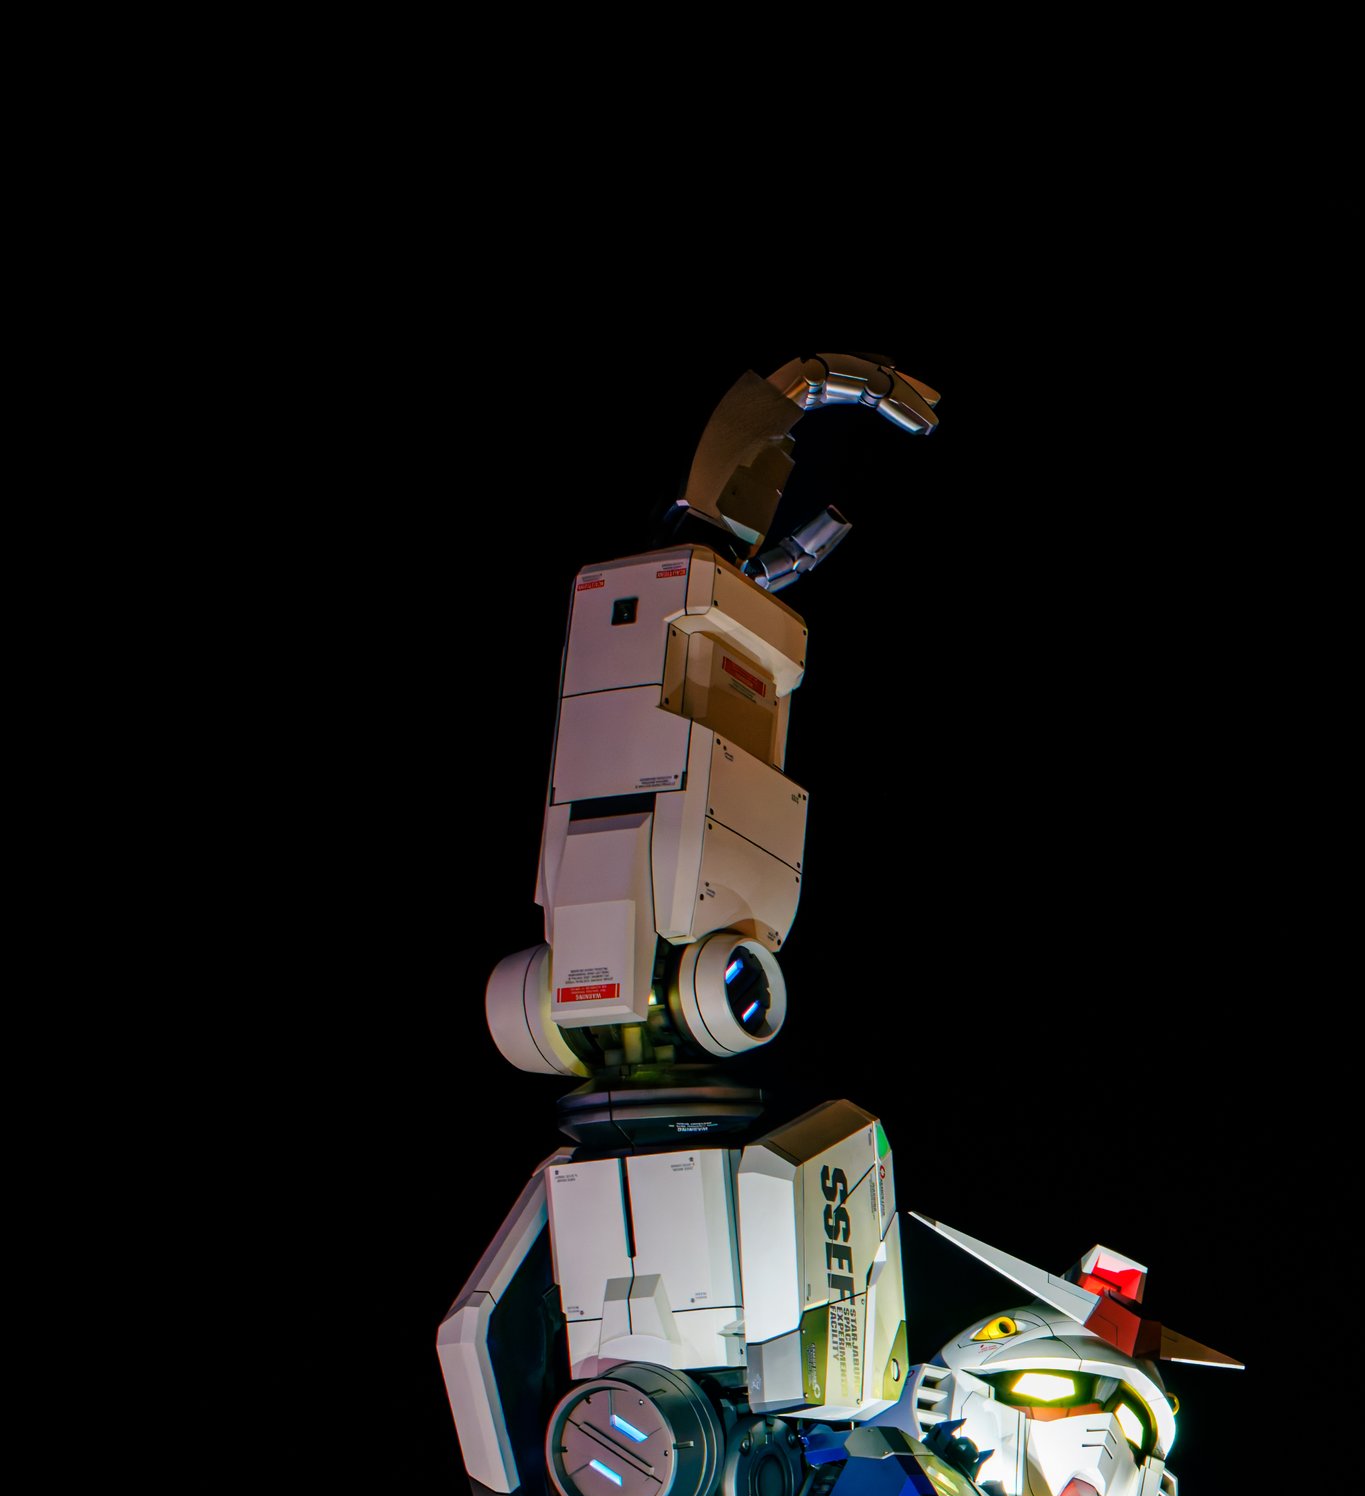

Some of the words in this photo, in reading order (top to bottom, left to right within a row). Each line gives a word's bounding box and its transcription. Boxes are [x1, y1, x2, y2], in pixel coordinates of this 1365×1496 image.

[819, 1164, 856, 1306] SSEF
[829, 1305, 840, 1362] FACILITY
[843, 1307, 852, 1349] SPACE
